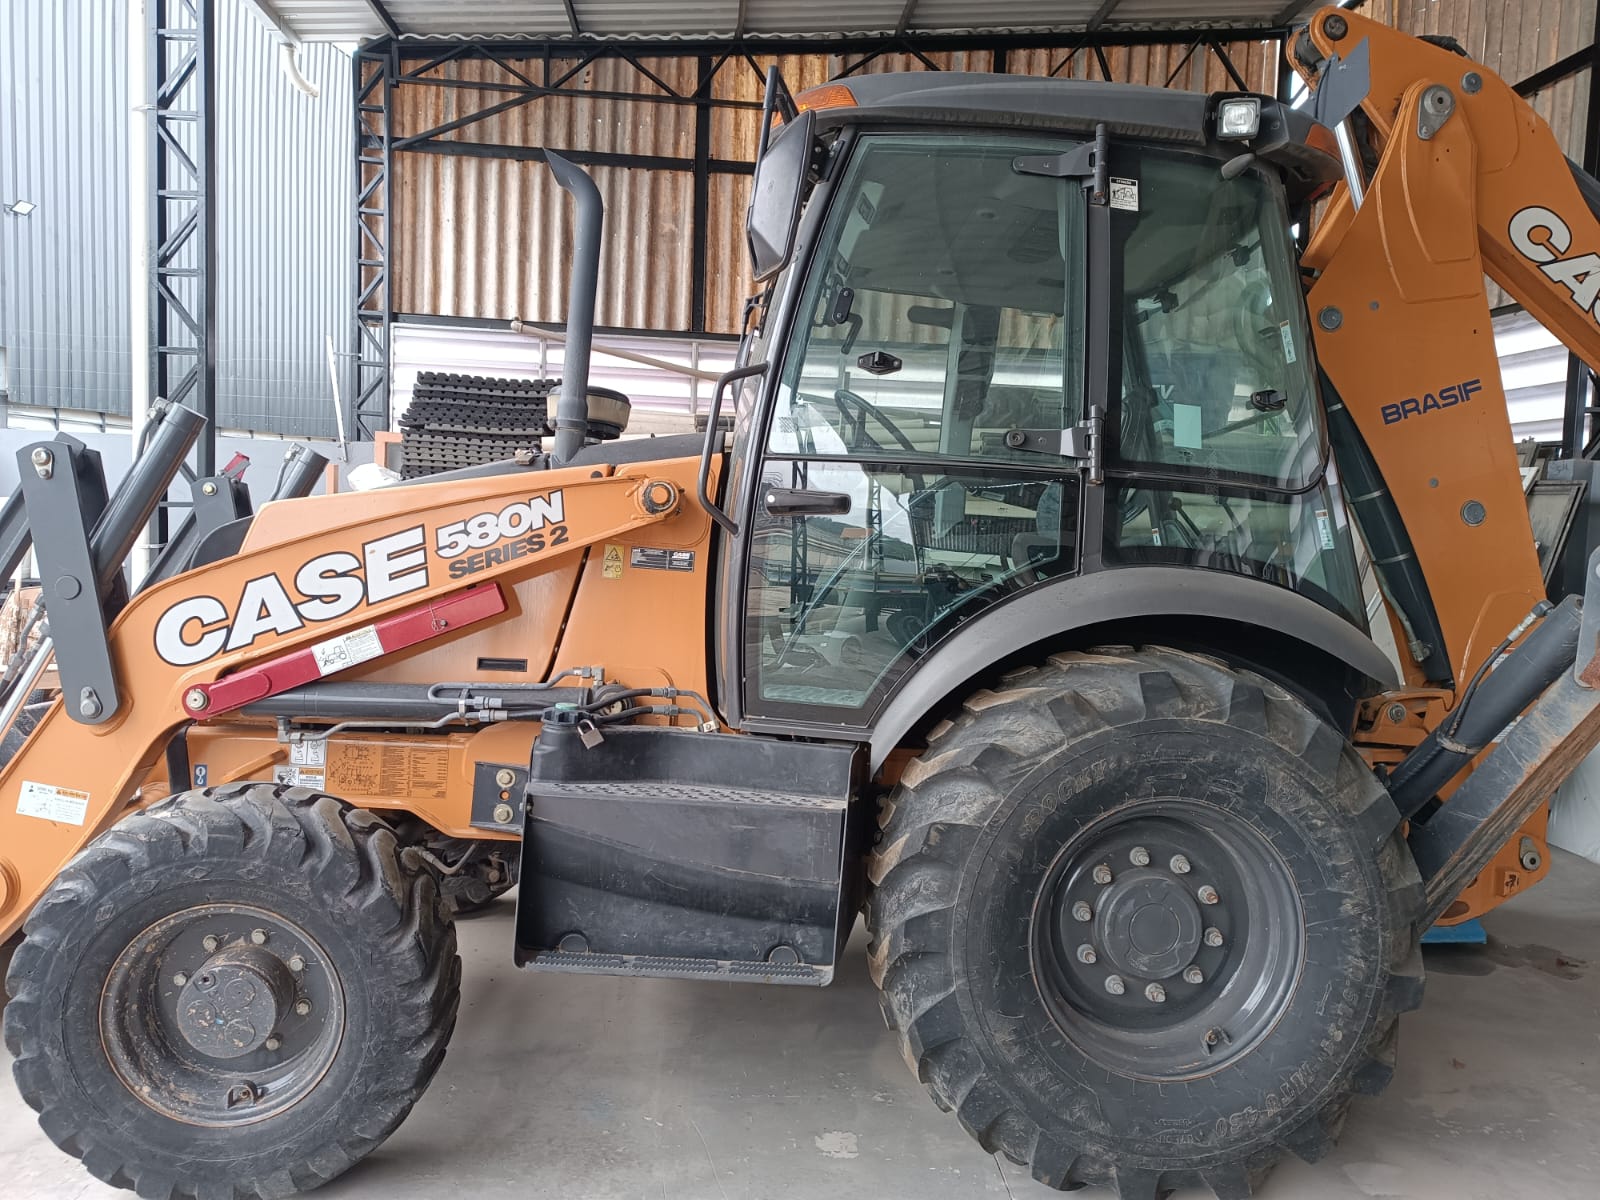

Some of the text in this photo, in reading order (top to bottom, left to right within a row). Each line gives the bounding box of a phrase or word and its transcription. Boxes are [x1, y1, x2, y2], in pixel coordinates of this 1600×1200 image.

[1508, 205, 1600, 326] CA
[1380, 378, 1482, 425] BRASIF
[154, 488, 566, 666] CASE 580N
[448, 525, 569, 580] SERIES 2
